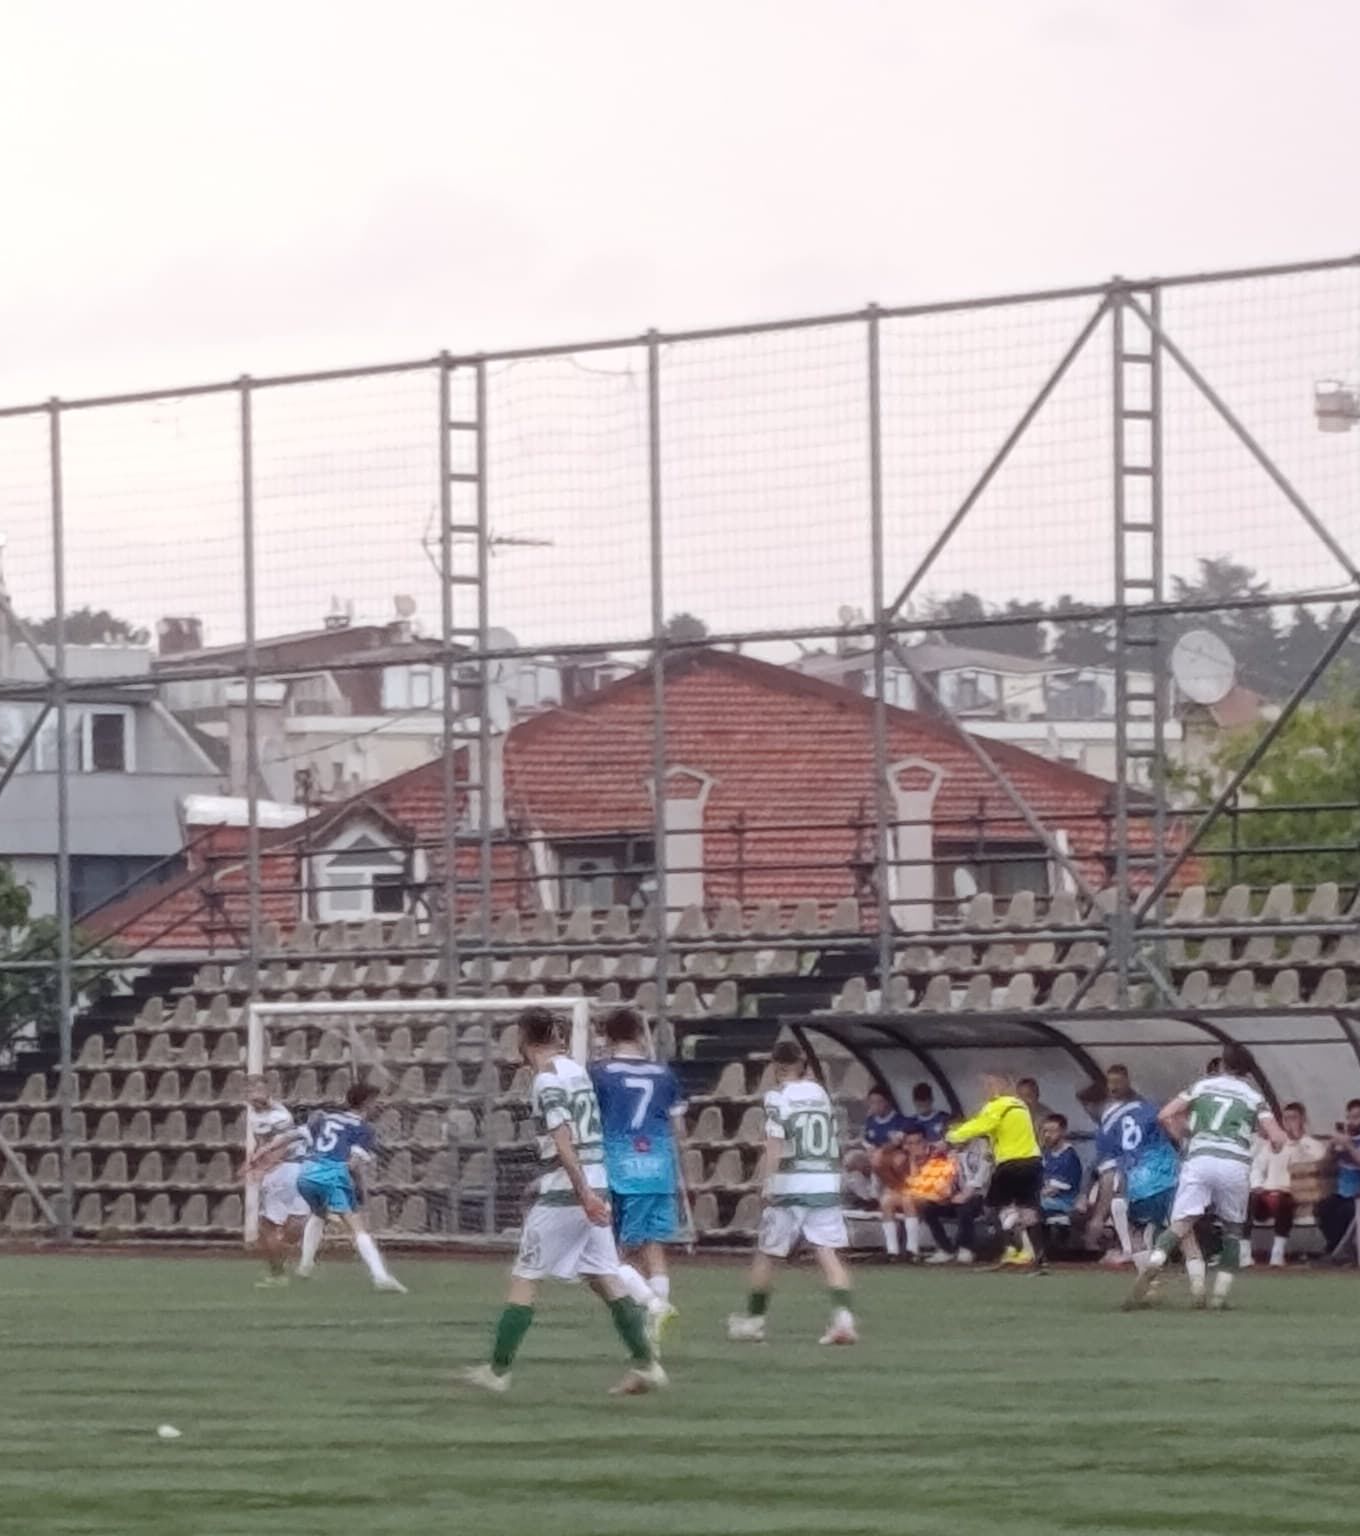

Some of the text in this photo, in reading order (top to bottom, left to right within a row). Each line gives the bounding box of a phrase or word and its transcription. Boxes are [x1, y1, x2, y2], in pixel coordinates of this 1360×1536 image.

[624, 1077, 654, 1131] 7
[1209, 1096, 1234, 1131] 7
[316, 1120, 345, 1152] 5
[795, 1112, 829, 1156] 10
[1121, 1115, 1142, 1150] 8
